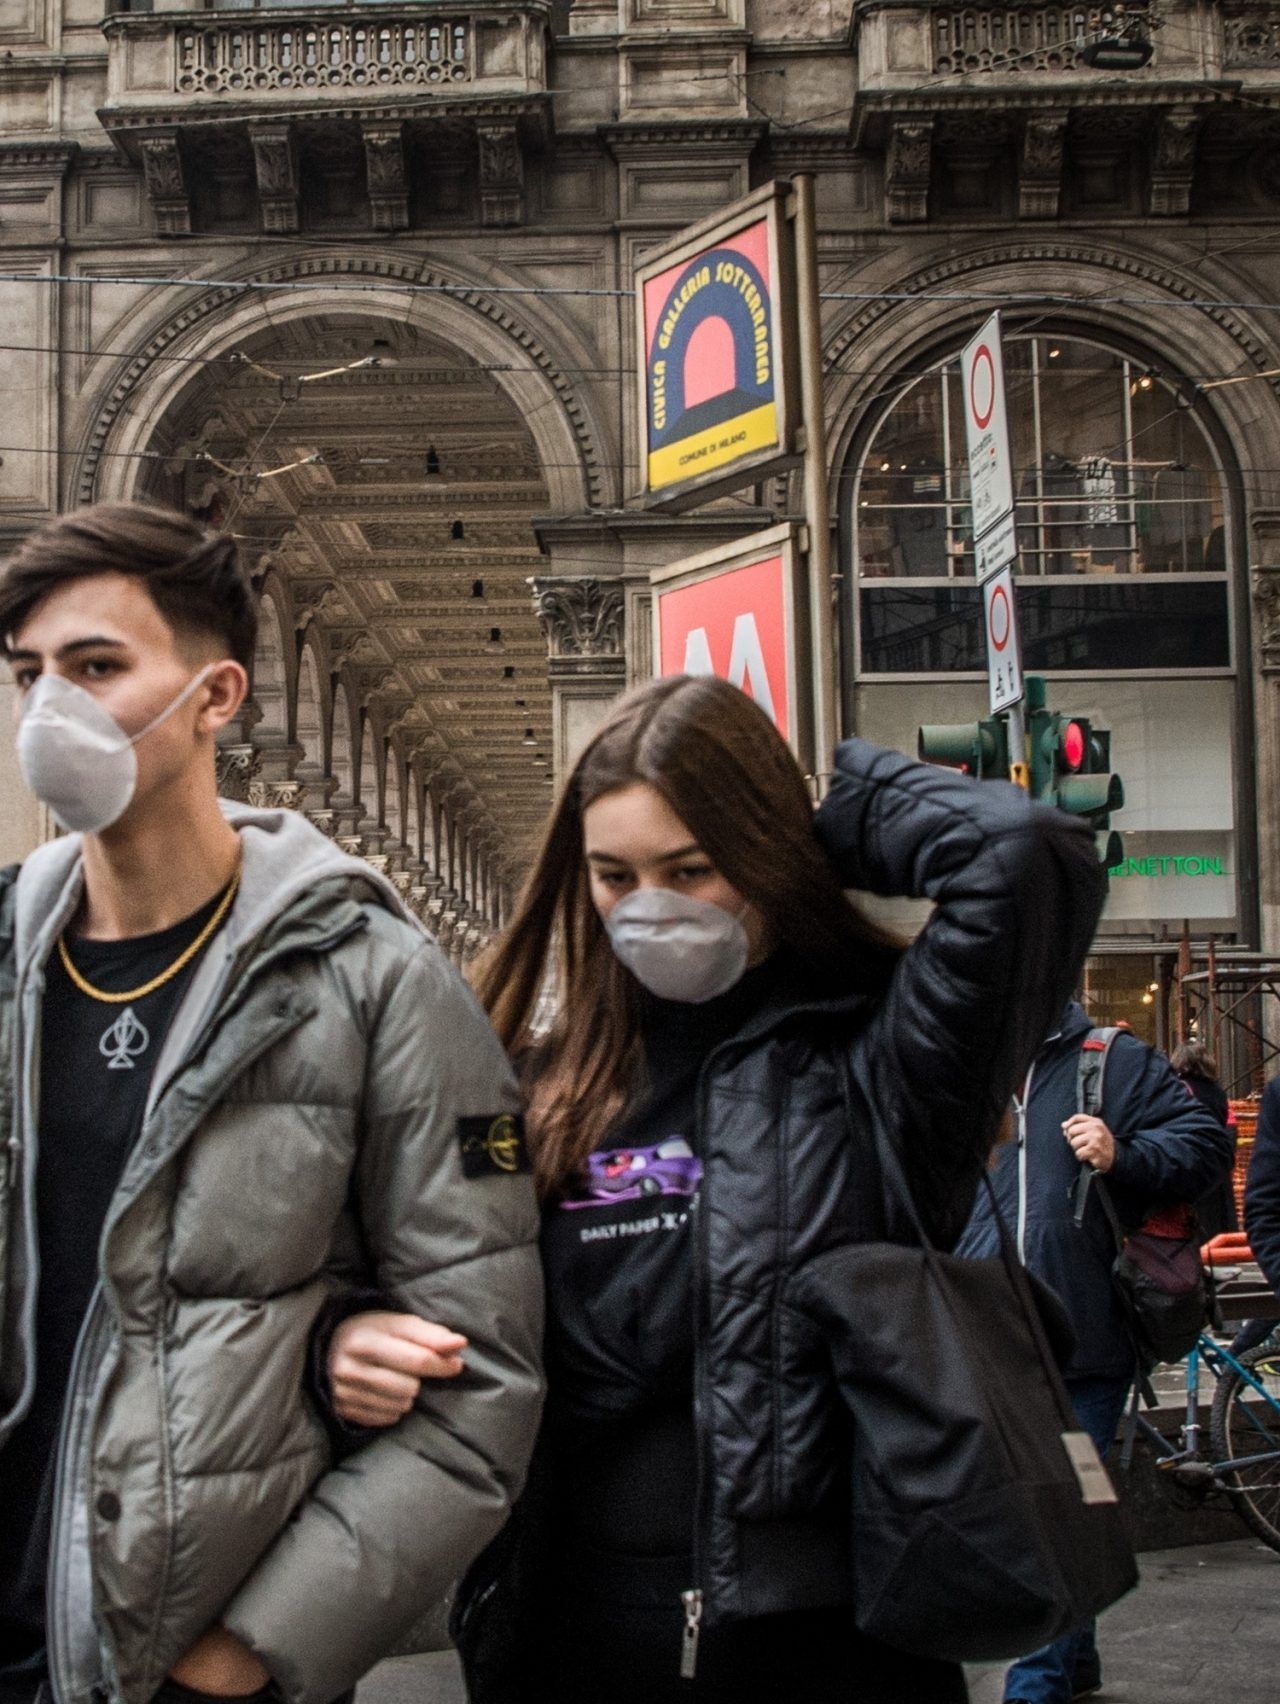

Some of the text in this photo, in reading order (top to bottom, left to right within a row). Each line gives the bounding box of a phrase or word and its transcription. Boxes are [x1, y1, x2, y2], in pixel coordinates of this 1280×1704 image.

[653, 261, 769, 430] CIVICA GALLERIA SOTTERRANEA
[679, 430, 747, 466] COMUNE DI MILANO
